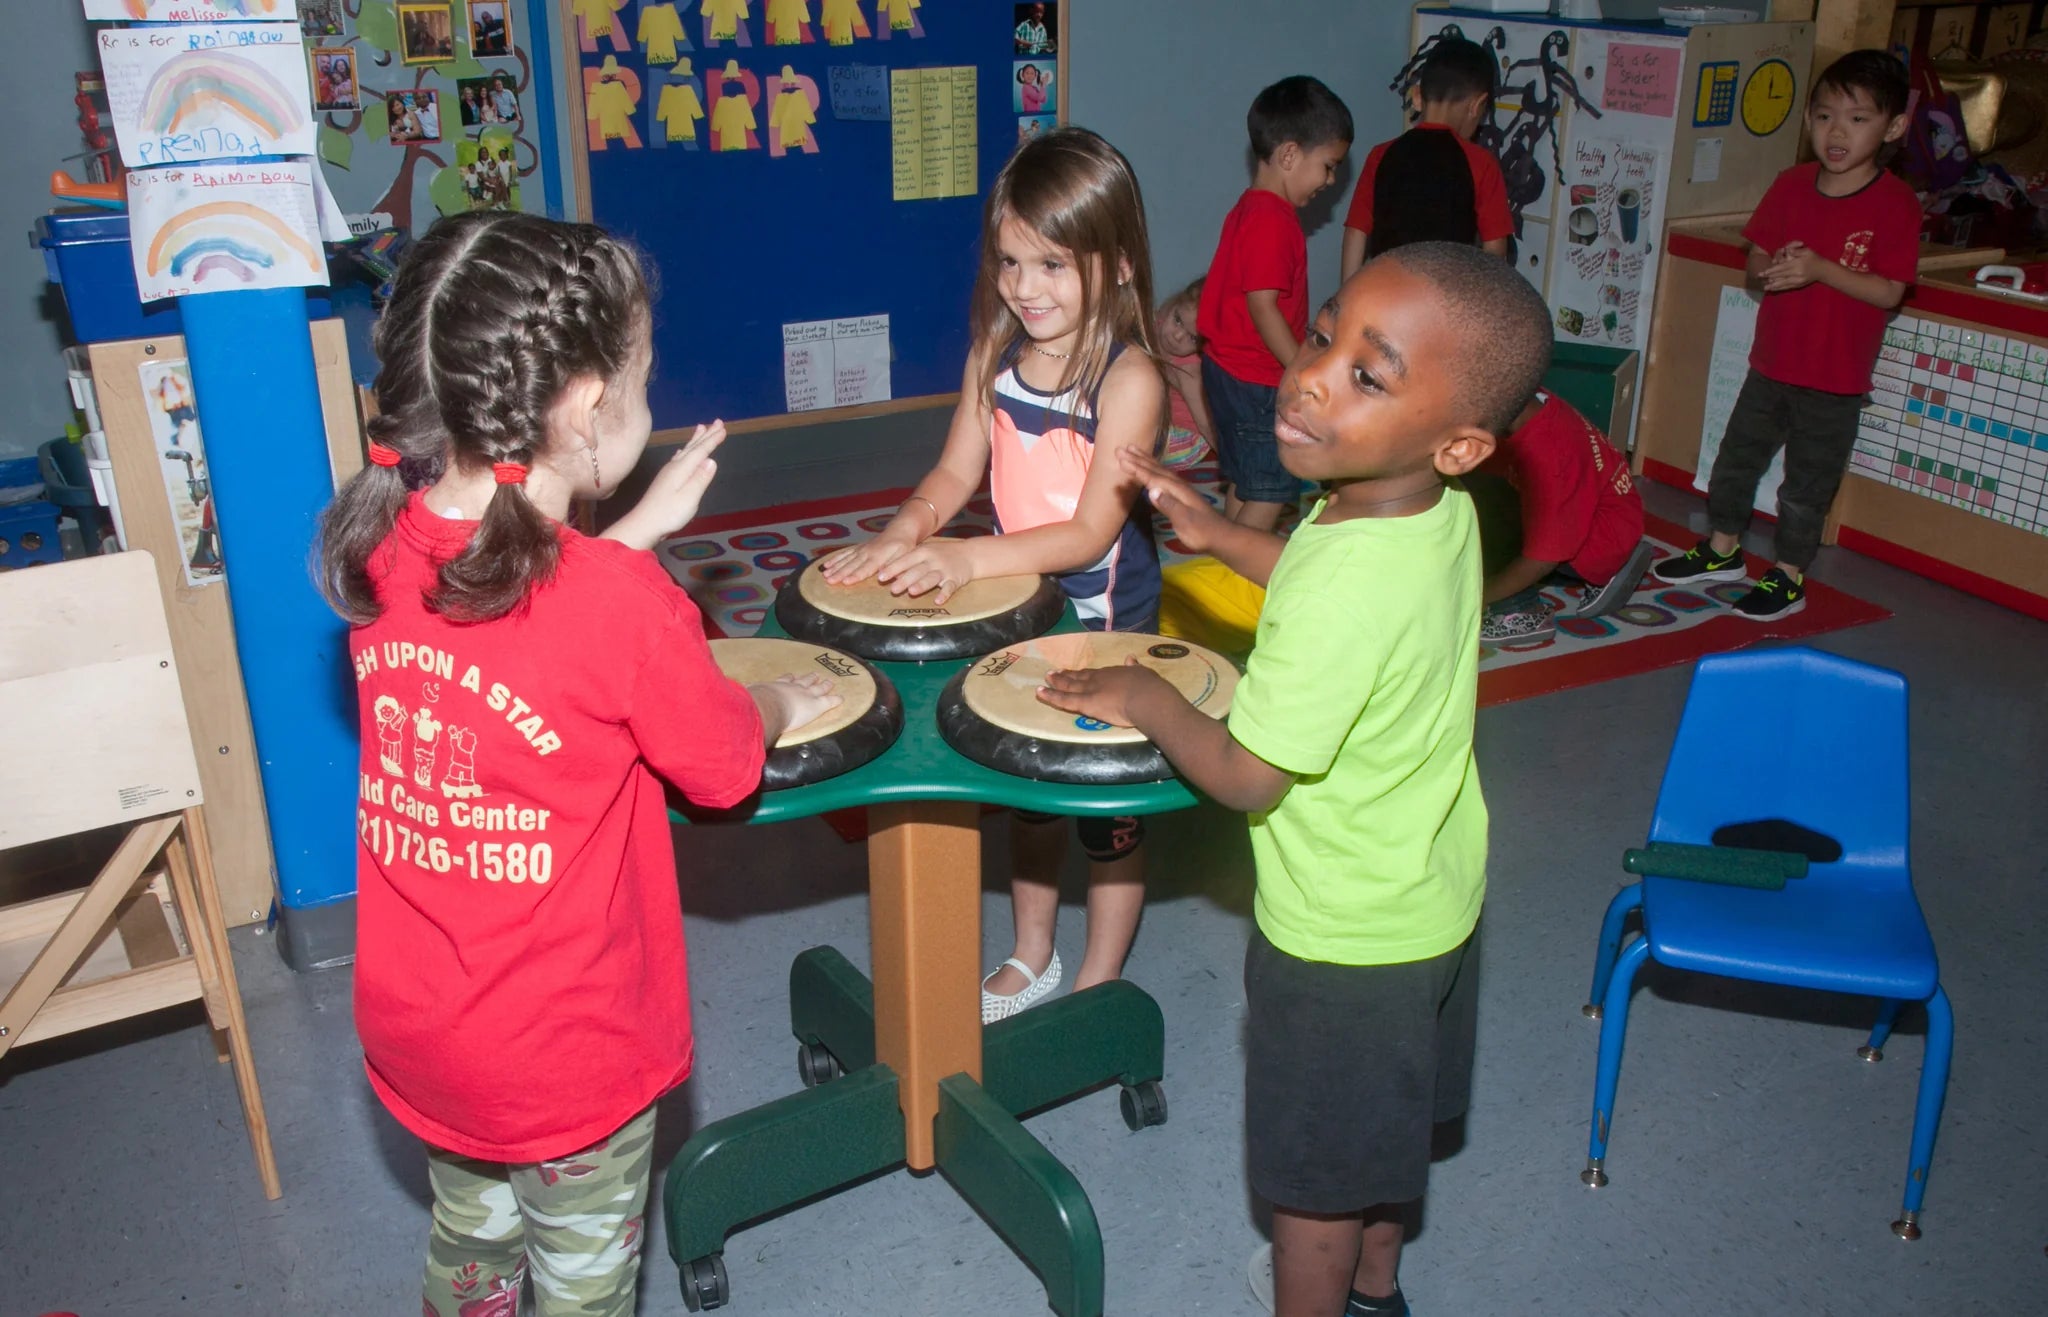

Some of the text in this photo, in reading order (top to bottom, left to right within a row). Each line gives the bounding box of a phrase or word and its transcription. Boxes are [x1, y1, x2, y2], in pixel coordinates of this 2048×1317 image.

[169, 7, 228, 22] Melissa
[101, 35, 118, 50] Rr
[129, 36, 139, 47] is
[149, 35, 175, 47] for
[129, 174, 141, 187] Rr
[149, 174, 158, 184] is
[164, 172, 185, 184] for
[348, 218, 379, 233] mily
[1948, 329, 1955, 341] 2
[1968, 334, 1976, 346] 3
[2013, 346, 2022, 358] 5
[2034, 351, 2044, 363] 6
[356, 641, 563, 756] SH UPON A STAR
[360, 772, 551, 832] ild Care Center
[358, 808, 552, 885] 21)726-1580
